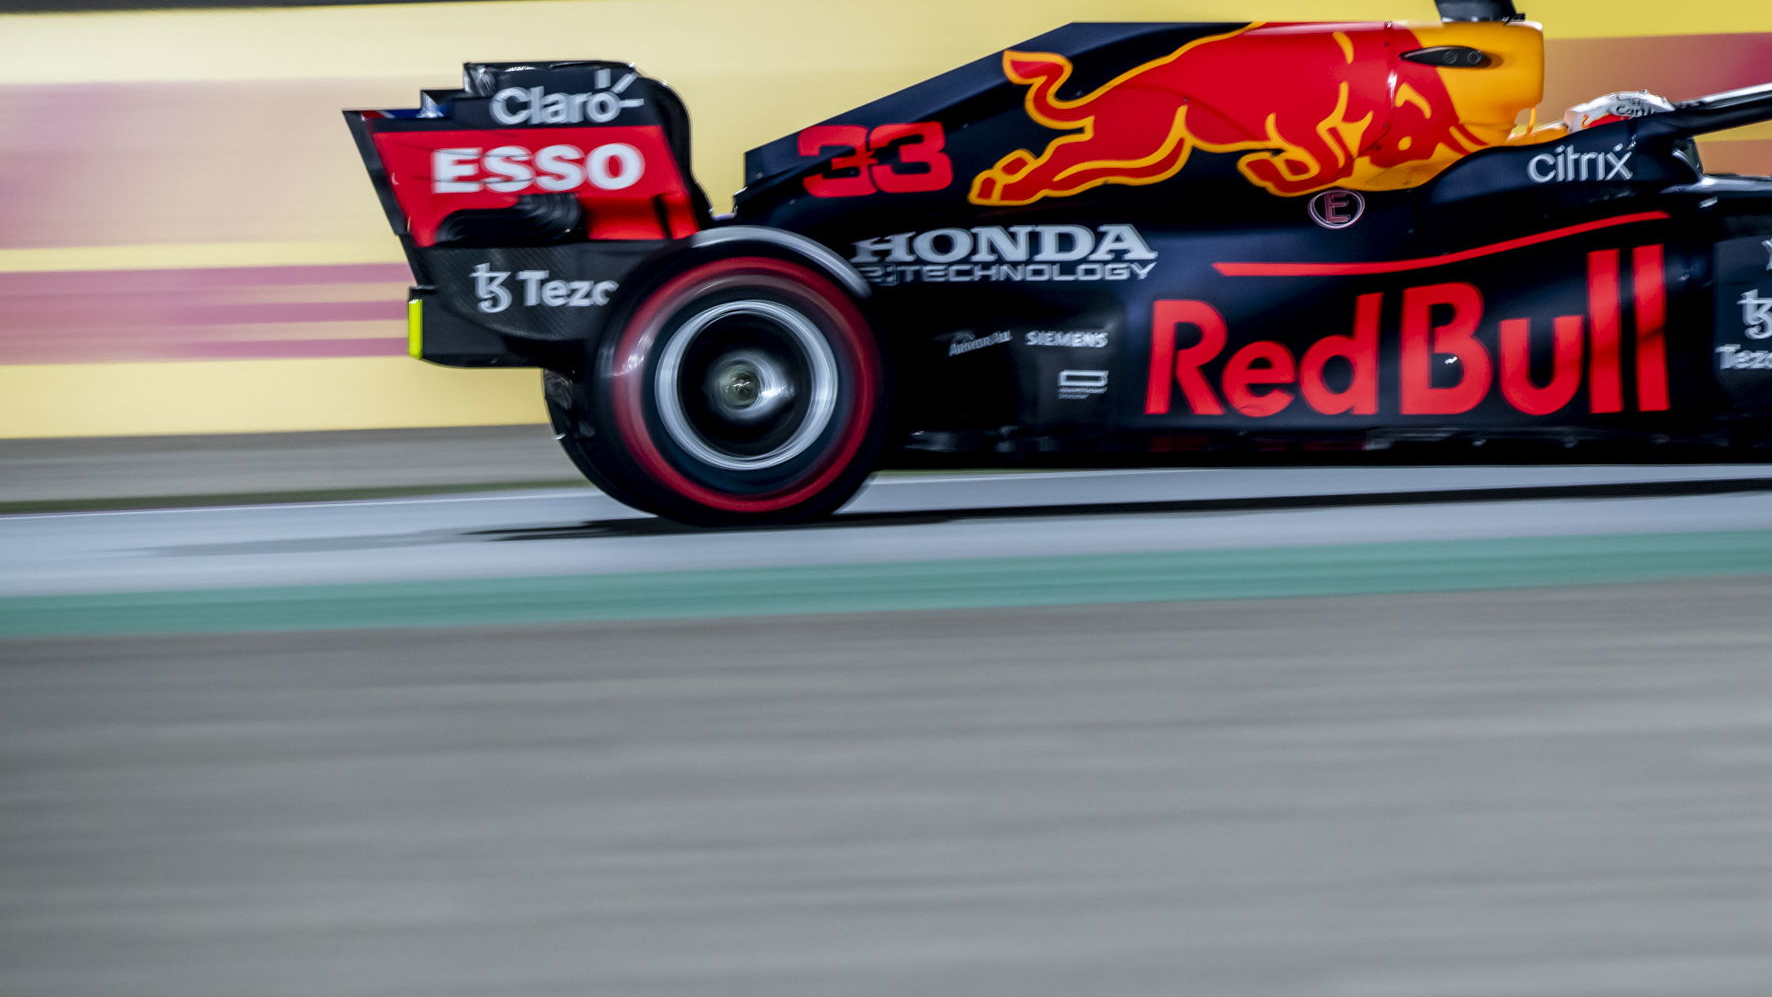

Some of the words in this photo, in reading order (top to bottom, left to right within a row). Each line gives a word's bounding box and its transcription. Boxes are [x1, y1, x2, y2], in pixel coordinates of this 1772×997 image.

[489, 84, 624, 125] Claro
[431, 142, 645, 194] ESSO
[797, 121, 953, 198] 33
[1527, 142, 1633, 184] citrix
[850, 223, 1158, 263] HONDA
[515, 270, 620, 307] Tezo
[1024, 330, 1109, 348] SIEMENS
[1143, 292, 1384, 419] Red
[1400, 243, 1671, 416] Bull
